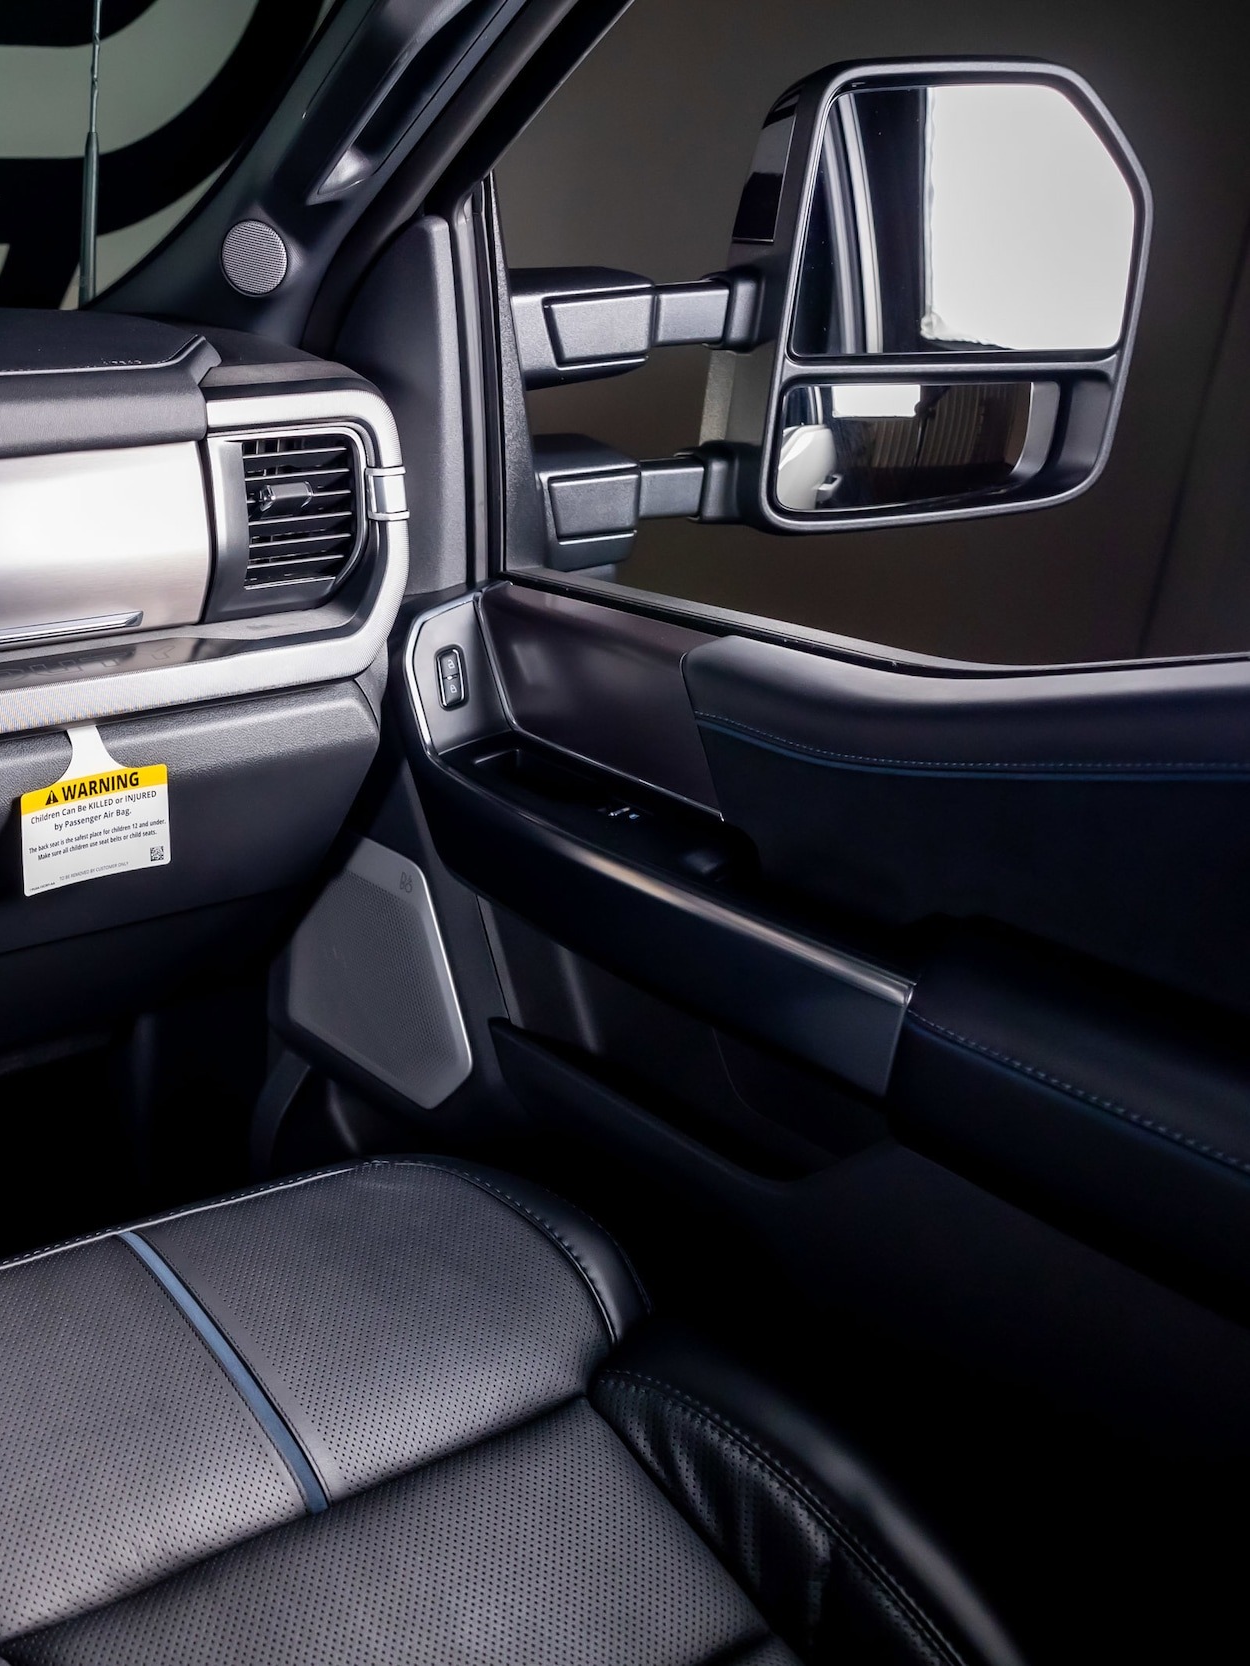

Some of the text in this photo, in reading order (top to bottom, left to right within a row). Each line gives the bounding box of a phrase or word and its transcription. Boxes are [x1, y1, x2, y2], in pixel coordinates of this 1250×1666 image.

[62, 772, 139, 801] WARNING
[30, 812, 60, 824] Children
[62, 807, 76, 816] Can
[78, 804, 86, 812] Be
[88, 798, 114, 810] KILLED
[125, 790, 156, 802] INJURED
[54, 808, 132, 831] by Passenger Air Bag.
[38, 844, 48, 852] back
[74, 834, 88, 842] safest
[90, 830, 102, 840] place
[111, 824, 130, 834] children
[38, 852, 50, 860] Make
[70, 844, 88, 852] children
[130, 831, 142, 839] child
